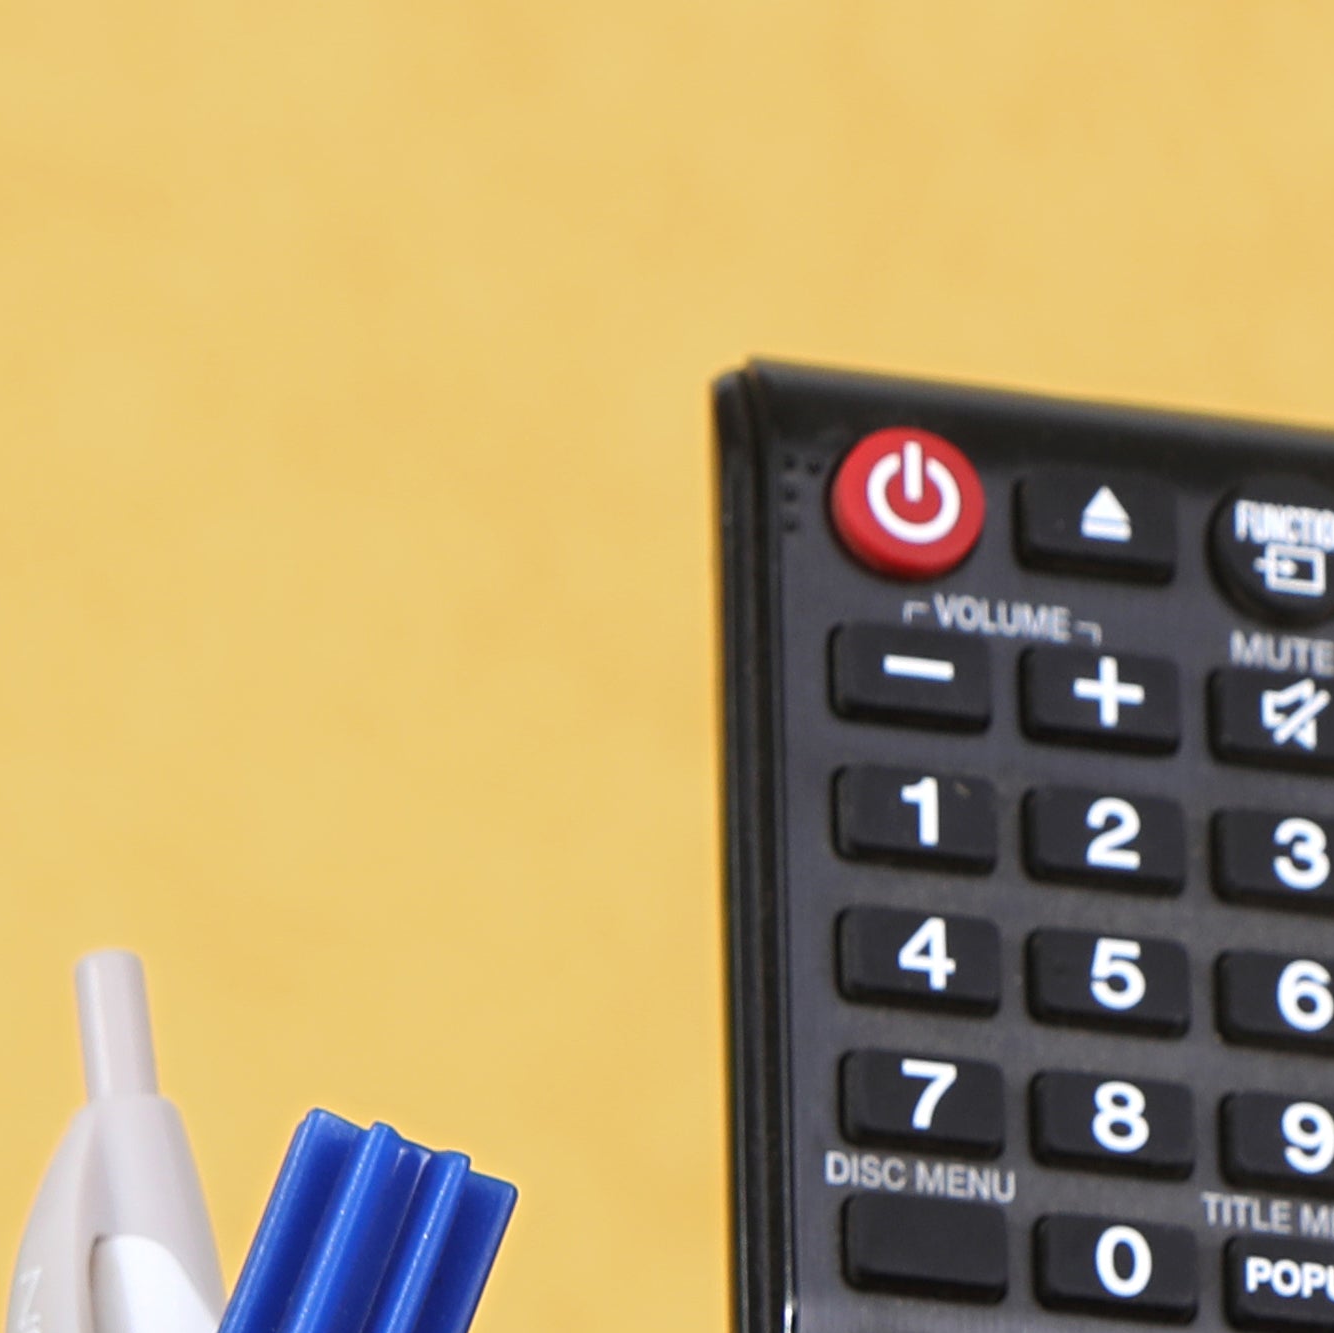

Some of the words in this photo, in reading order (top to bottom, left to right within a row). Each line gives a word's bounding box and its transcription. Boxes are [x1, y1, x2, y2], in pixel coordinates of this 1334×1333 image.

[933, 593, 1071, 643] VOLUME
[901, 777, 939, 846] 1
[1086, 797, 1141, 869] 2
[1274, 818, 1330, 889] 3
[898, 917, 956, 990] 4
[1091, 938, 1146, 1009] 5
[1277, 960, 1334, 1031] 6
[901, 1059, 957, 1129] 7
[1092, 1081, 1149, 1152] 8
[824, 1150, 907, 1192] DISC
[914, 1160, 1017, 1204] MENU
[1200, 1190, 1292, 1235] TITLE
[1095, 1225, 1152, 1297] 0
